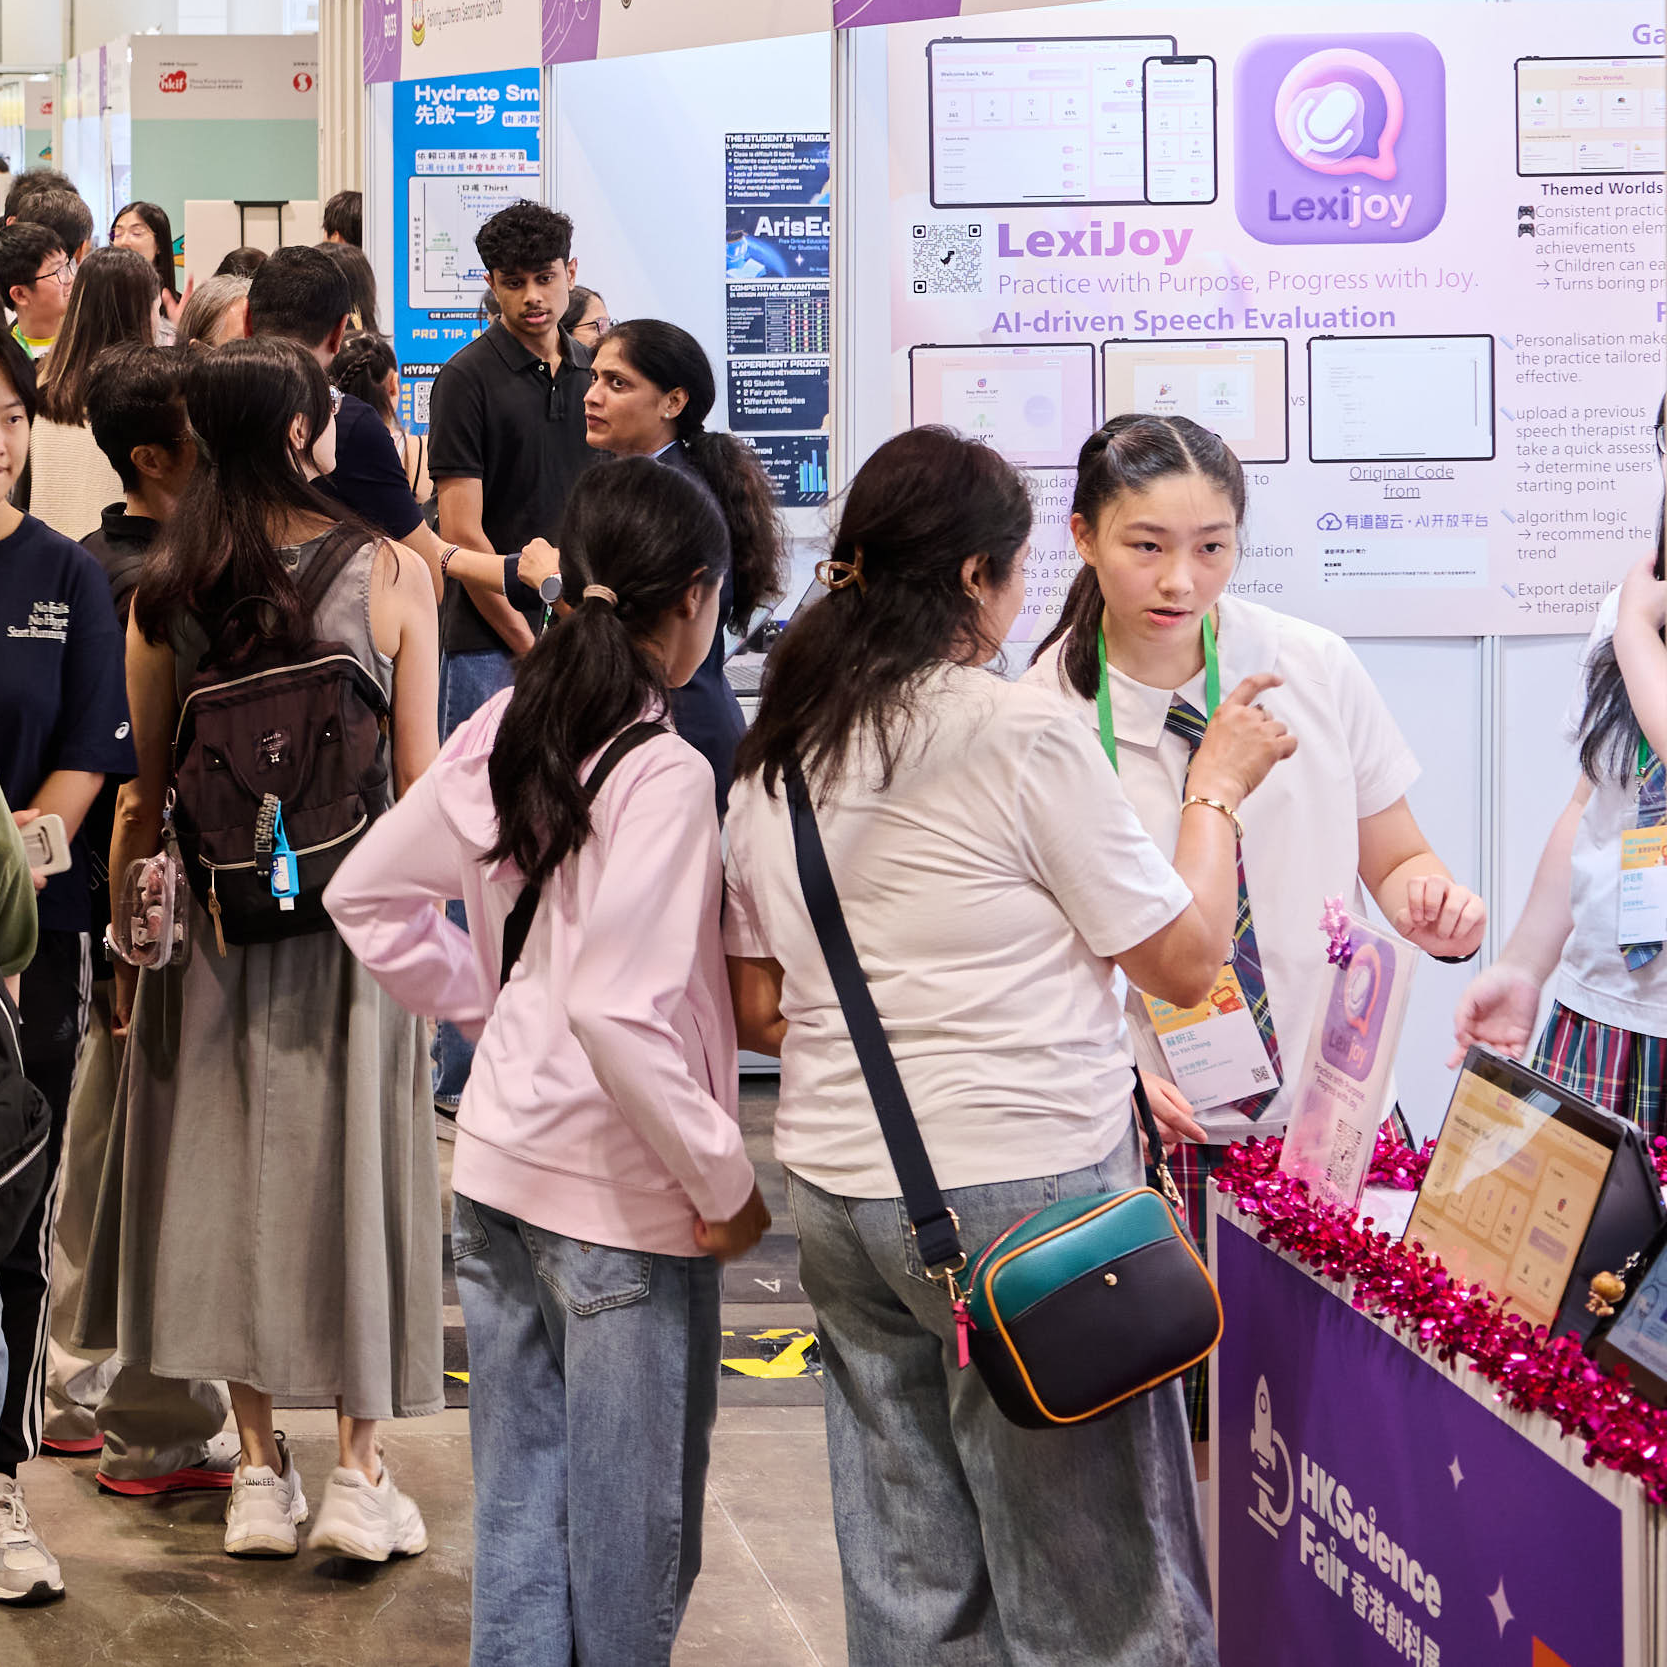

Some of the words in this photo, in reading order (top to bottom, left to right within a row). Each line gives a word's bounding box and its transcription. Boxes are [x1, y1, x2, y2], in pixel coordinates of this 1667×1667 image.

[415, 84, 500, 105] Hydrate
[415, 104, 496, 126] 先飲一步
[1540, 182, 1604, 196] Themed
[1609, 181, 1663, 195] Worlds
[1268, 184, 1412, 229] Lexijoy
[1536, 205, 1612, 219] Consistent
[1536, 222, 1629, 238] Gamification
[997, 220, 1194, 266] LexiJoy
[1536, 240, 1636, 255] achievements
[1554, 259, 1615, 272] Children
[1619, 262, 1645, 272] can
[998, 272, 1091, 296] Practice
[1099, 272, 1152, 294] with
[1158, 271, 1261, 298] Purpose,
[1268, 269, 1369, 297] Progress
[1375, 268, 1429, 289] with
[1435, 268, 1479, 294] Joy.
[1555, 277, 1594, 291] Turns
[1597, 276, 1646, 293] boring
[992, 310, 1124, 334] AI-driven
[1133, 308, 1235, 337] Speech
[1244, 304, 1396, 330] Evaluation
[412, 328, 438, 339] PRO
[1515, 333, 1625, 348] Personalisation
[1515, 352, 1540, 365] the
[1544, 352, 1601, 368] practice
[1605, 350, 1661, 364] tailored
[1515, 369, 1582, 384] effective.
[1515, 405, 1567, 421] upload
[1571, 409, 1580, 419] a
[1584, 405, 1646, 421] previous
[1516, 423, 1567, 440] speech
[1571, 423, 1636, 439] therapist
[1516, 443, 1548, 456] take
[1551, 446, 1560, 456] a
[1564, 442, 1603, 460] quick
[1349, 465, 1410, 483] Original
[1414, 465, 1455, 480] Code
[1535, 460, 1611, 475] determine
[1383, 484, 1421, 499] from
[1516, 479, 1572, 495] starting
[1577, 478, 1616, 494] point
[1517, 510, 1588, 527] algorithm
[1592, 509, 1628, 525] logic
[1536, 528, 1624, 541] recommend
[1628, 527, 1652, 540] the
[1517, 546, 1557, 560] trend
[1517, 583, 1565, 598] Export
[1536, 600, 1601, 616] therapist
[1300, 1452, 1442, 1619] HKScience
[1300, 1514, 1349, 1598] Fair
